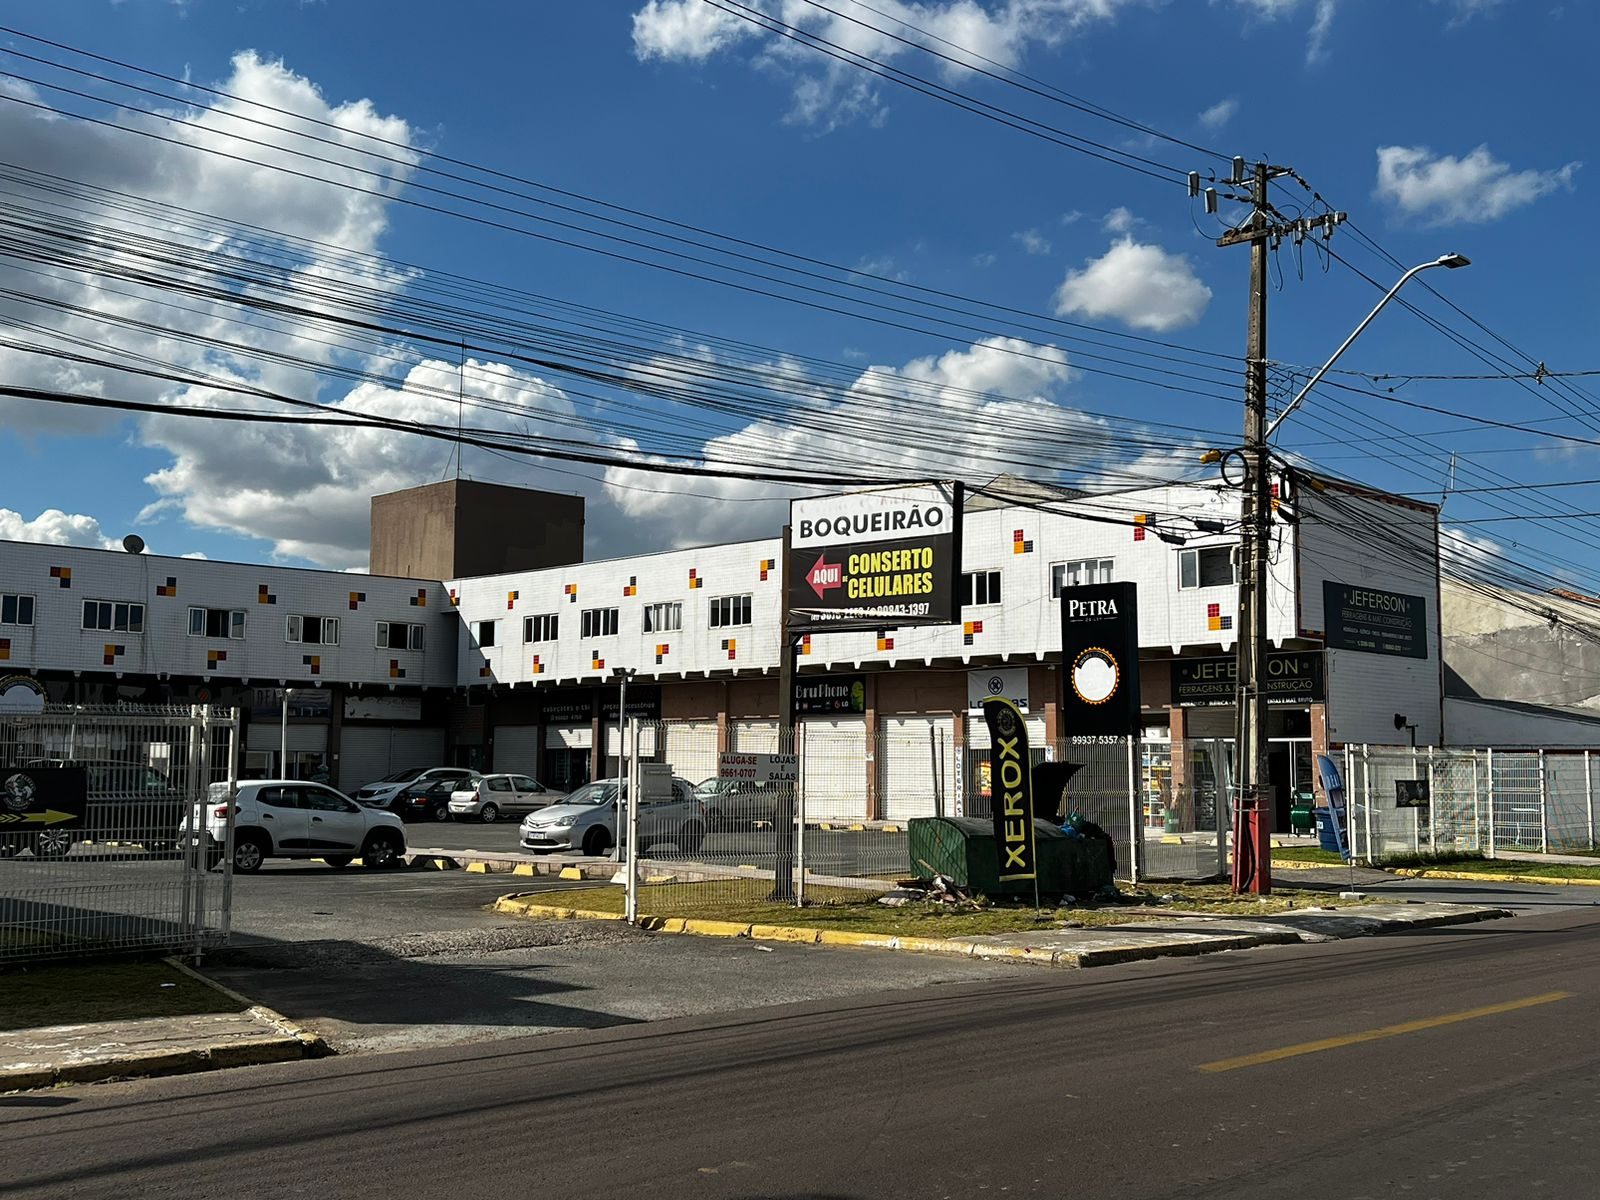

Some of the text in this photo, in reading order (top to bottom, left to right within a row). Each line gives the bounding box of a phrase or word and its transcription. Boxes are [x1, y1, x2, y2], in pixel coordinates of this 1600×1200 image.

[800, 505, 943, 538] BOQUEIRÃO
[848, 547, 933, 575] CONSERTO
[813, 568, 838, 584] AQUI
[848, 572, 933, 599] CELULARES
[1069, 599, 1118, 617] PETRA
[1349, 589, 1406, 613] JEFERSON
[1192, 658, 1298, 680] JEFEON
[1179, 684, 1223, 694] FERRAGENS
[1225, 683, 1231, 692] &
[1267, 680, 1313, 690] NSTRUÇÃO
[1072, 735, 1118, 745] 99937 5357
[721, 755, 757, 765] ALUGA-SE
[769, 755, 796, 764] LOJAS
[769, 772, 796, 781] SALAS
[998, 736, 1026, 868] XEROX
